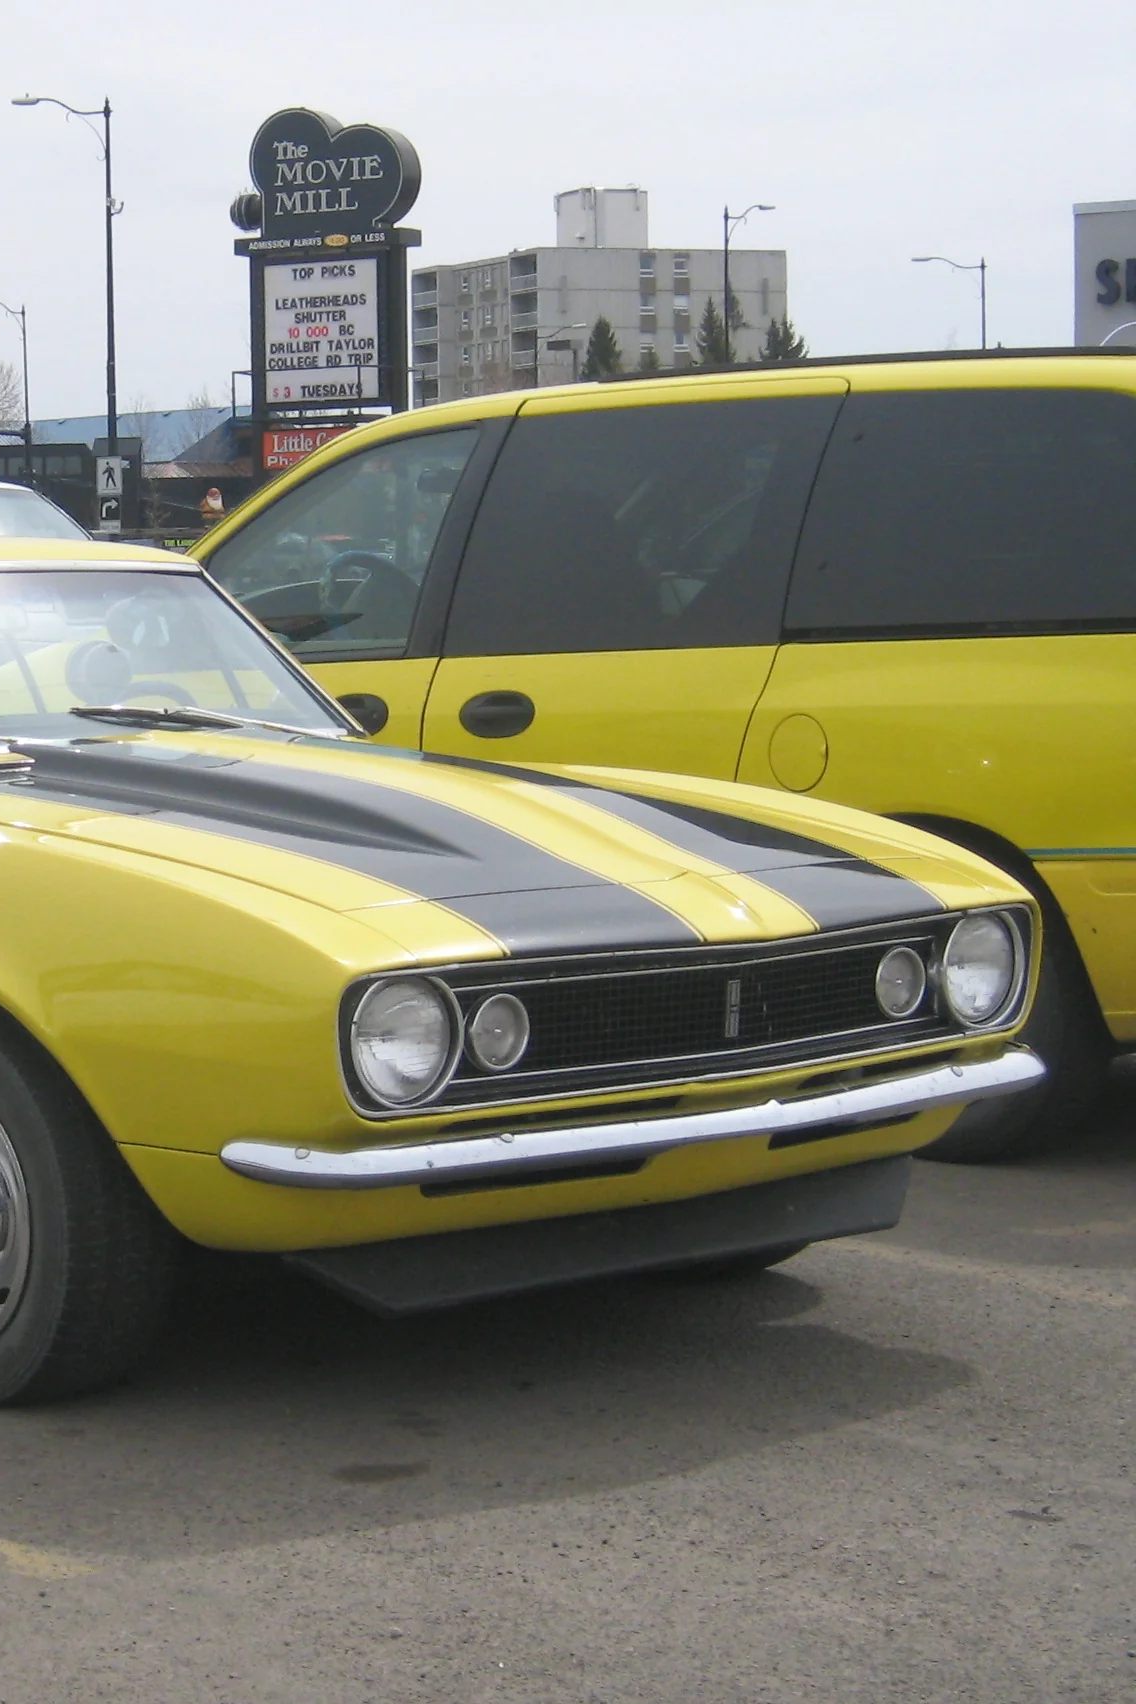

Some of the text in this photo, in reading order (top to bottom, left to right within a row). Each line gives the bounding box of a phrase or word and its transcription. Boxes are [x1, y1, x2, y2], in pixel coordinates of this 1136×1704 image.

[272, 141, 309, 160] The
[274, 154, 384, 186] MOVIE
[274, 187, 359, 216] MILL
[248, 239, 291, 250] ADMISSION
[293, 237, 322, 247] ALWAYS
[350, 234, 362, 243] OR
[365, 233, 385, 242] LESS
[292, 264, 356, 281] TOP PICKS
[275, 293, 367, 311] LEATHERHEADS
[294, 310, 347, 325] SHUTTER
[288, 324, 355, 339] 10 000 BC
[269, 338, 375, 355] DRILLBIT TAYLOR
[268, 352, 374, 370] COLLEGE RD TRIP
[283, 386, 292, 399] 3
[300, 383, 363, 398] TUESDAYS
[272, 433, 314, 453] Little
